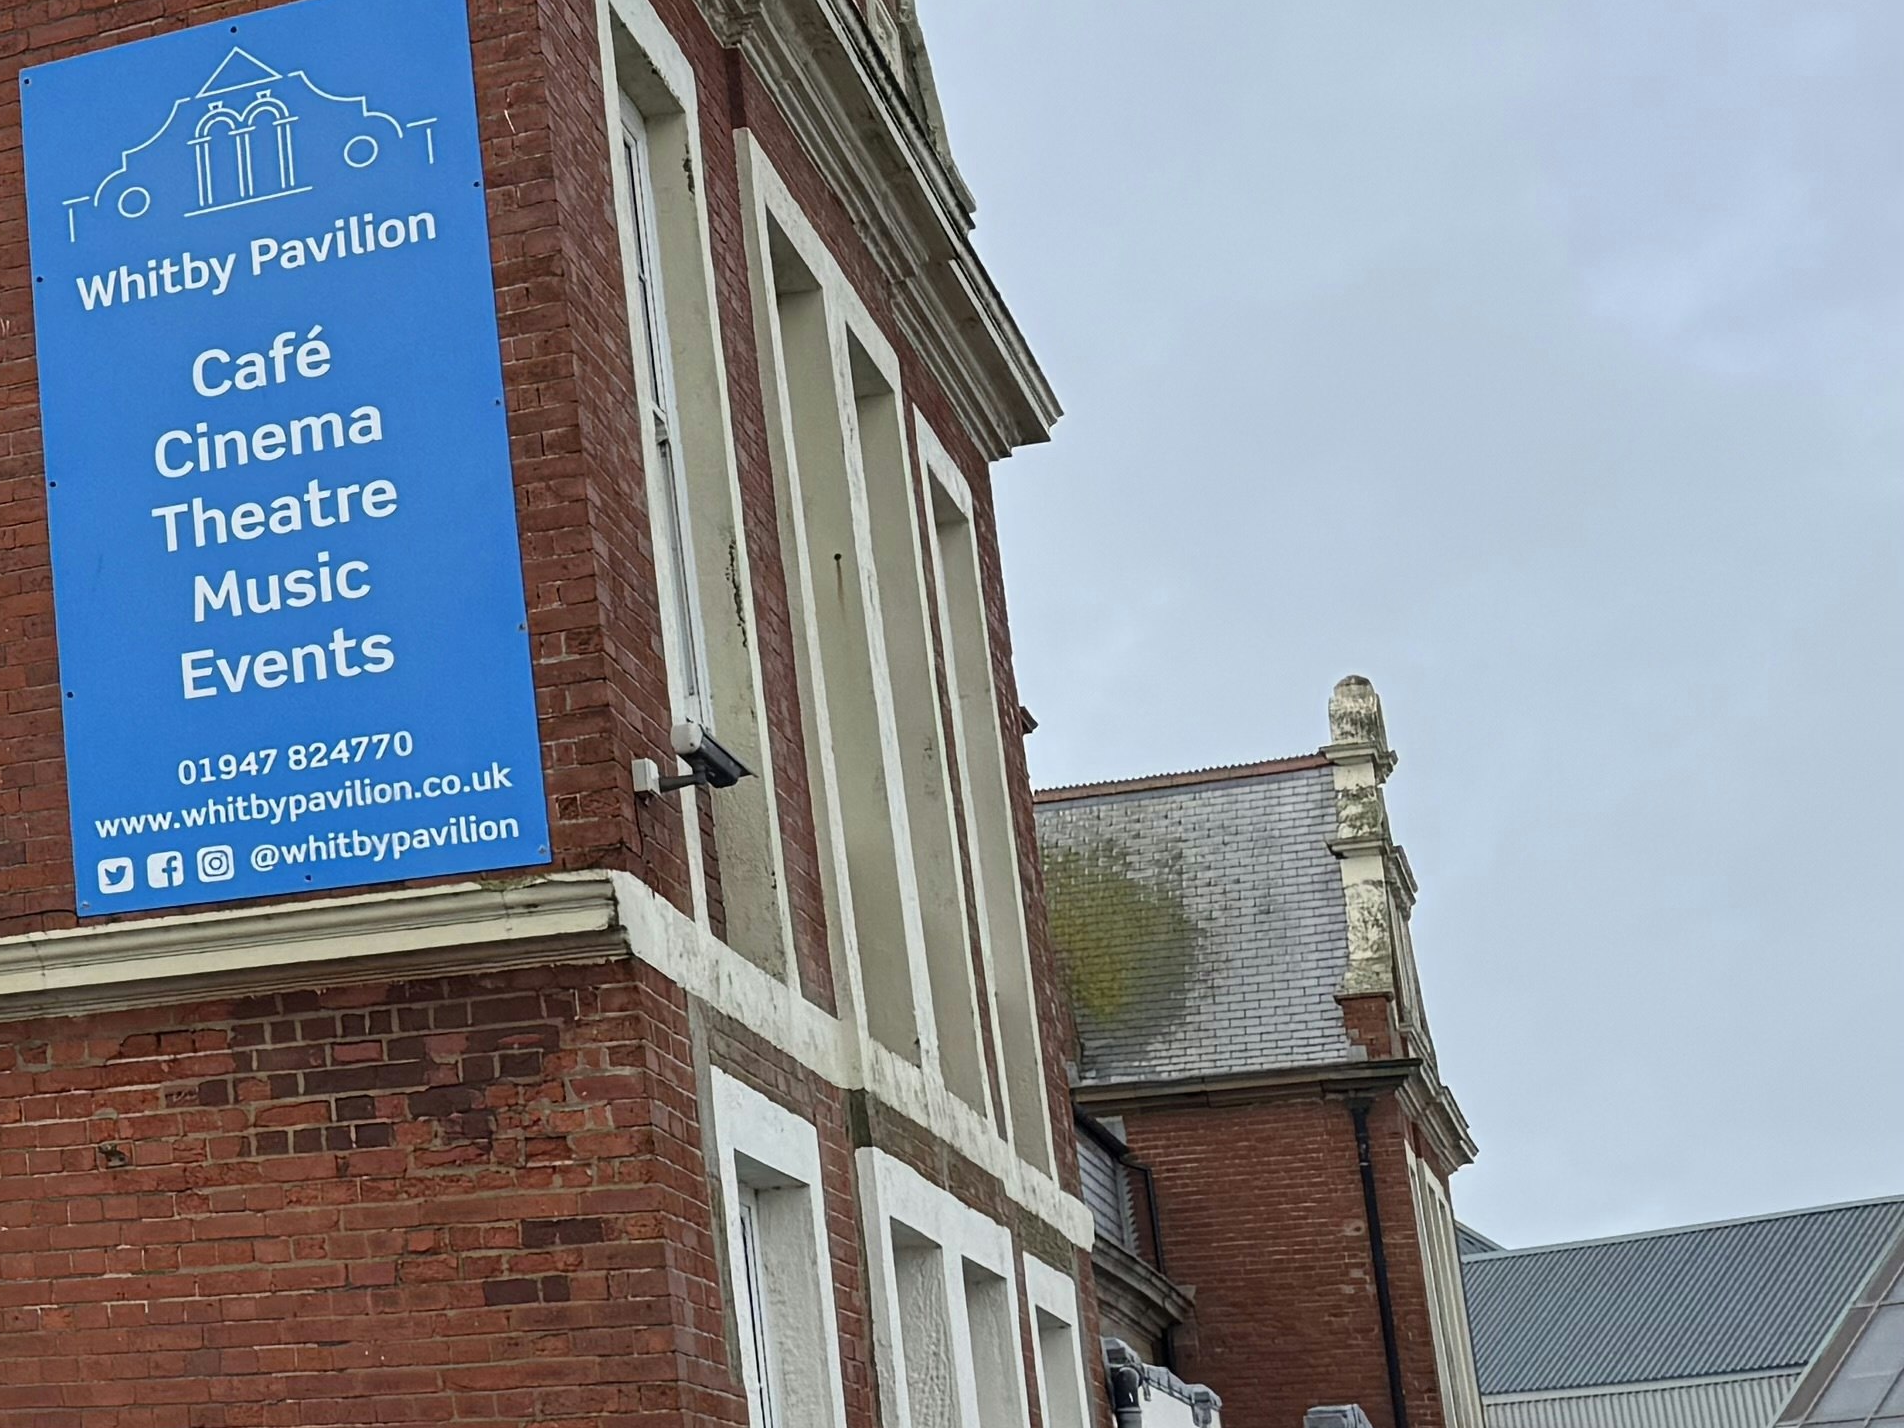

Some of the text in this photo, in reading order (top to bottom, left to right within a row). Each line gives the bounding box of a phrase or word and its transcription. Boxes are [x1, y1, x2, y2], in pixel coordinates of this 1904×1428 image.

[76, 213, 435, 310] Whitby Pavilion
[193, 325, 330, 396] Café
[155, 406, 382, 477] Cinema
[152, 480, 396, 551] Theatre
[195, 551, 370, 622] Music
[182, 628, 394, 699] Events
[179, 731, 412, 785] 01947 824770
[95, 762, 512, 837] www.whitbypavilion.co.uk
[251, 816, 518, 871] @whitbypavilion
